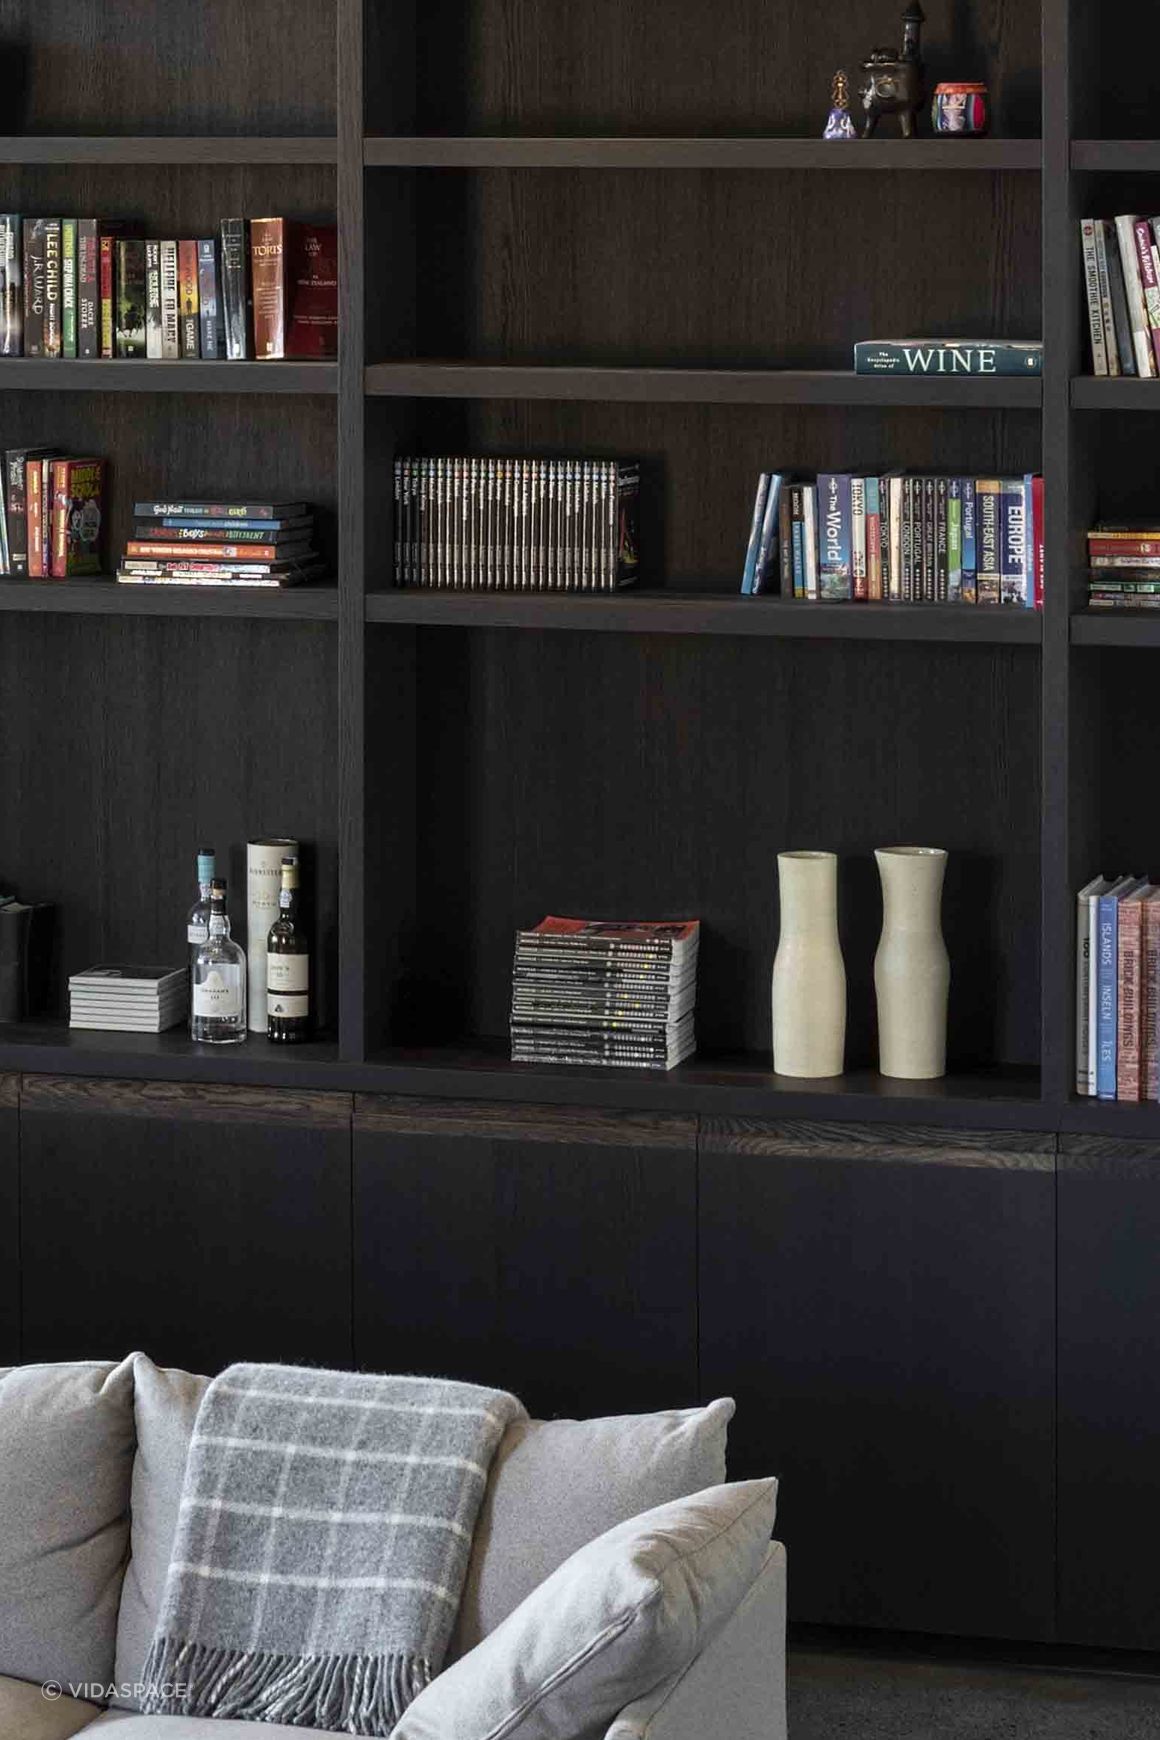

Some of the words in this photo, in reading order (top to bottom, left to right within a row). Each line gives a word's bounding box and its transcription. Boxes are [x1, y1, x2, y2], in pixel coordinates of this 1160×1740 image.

[46, 233, 58, 257] LEE
[1085, 246, 1095, 262] THE
[32, 275, 44, 315] WARD
[46, 260, 58, 300] CHILD
[1087, 265, 1099, 306] SMOOTHIE
[185, 323, 194, 350] GAME
[1090, 310, 1102, 345] KITCHEN
[902, 349, 996, 372] WINE
[792, 492, 800, 516] MOON
[829, 495, 838, 511] The
[852, 483, 864, 516] TOKYO
[826, 511, 842, 561] World
[938, 521, 946, 554] FRANCE
[962, 501, 974, 539] Portugal
[982, 495, 995, 549] SOUTH-EAST
[1008, 505, 1023, 564] EUROPE
[903, 521, 911, 555] LONDON
[914, 521, 922, 565] PORTUGAL
[982, 550, 995, 571] ASIA
[1101, 922, 1112, 965] ISLANDS
[1123, 950, 1134, 982] BRICK
[1146, 949, 1157, 984] BRICK
[1101, 985, 1112, 1020] INSELN
[1123, 987, 1134, 1047] BUILDINGS
